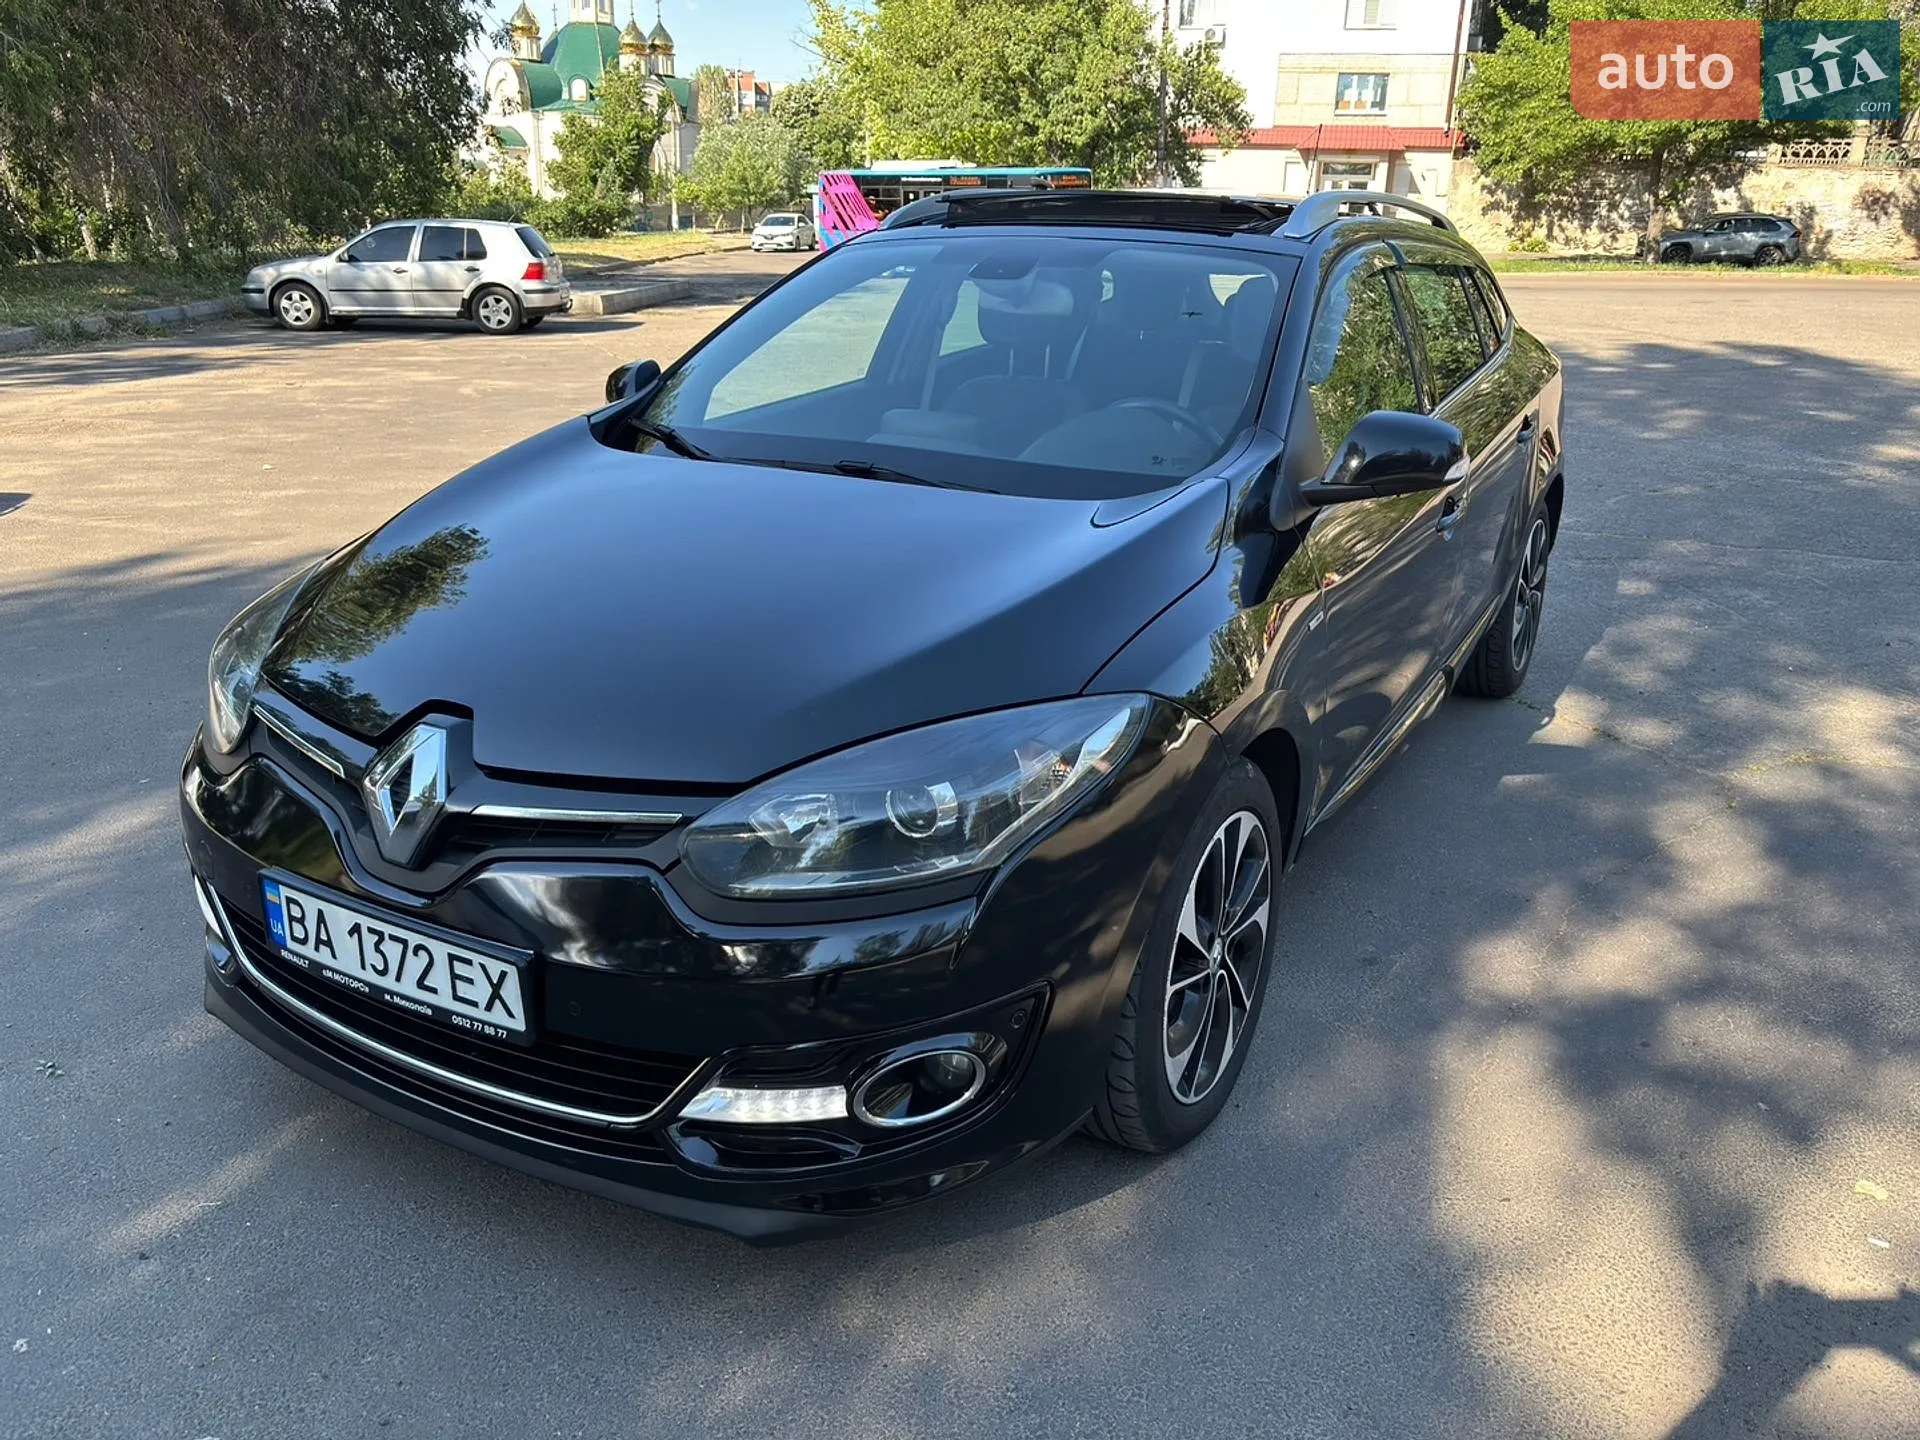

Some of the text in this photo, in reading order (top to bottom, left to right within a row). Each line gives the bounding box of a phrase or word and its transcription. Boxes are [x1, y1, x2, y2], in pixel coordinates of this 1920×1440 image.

[270, 918, 284, 936] UA
[285, 895, 516, 1019] BA 1372 EX
